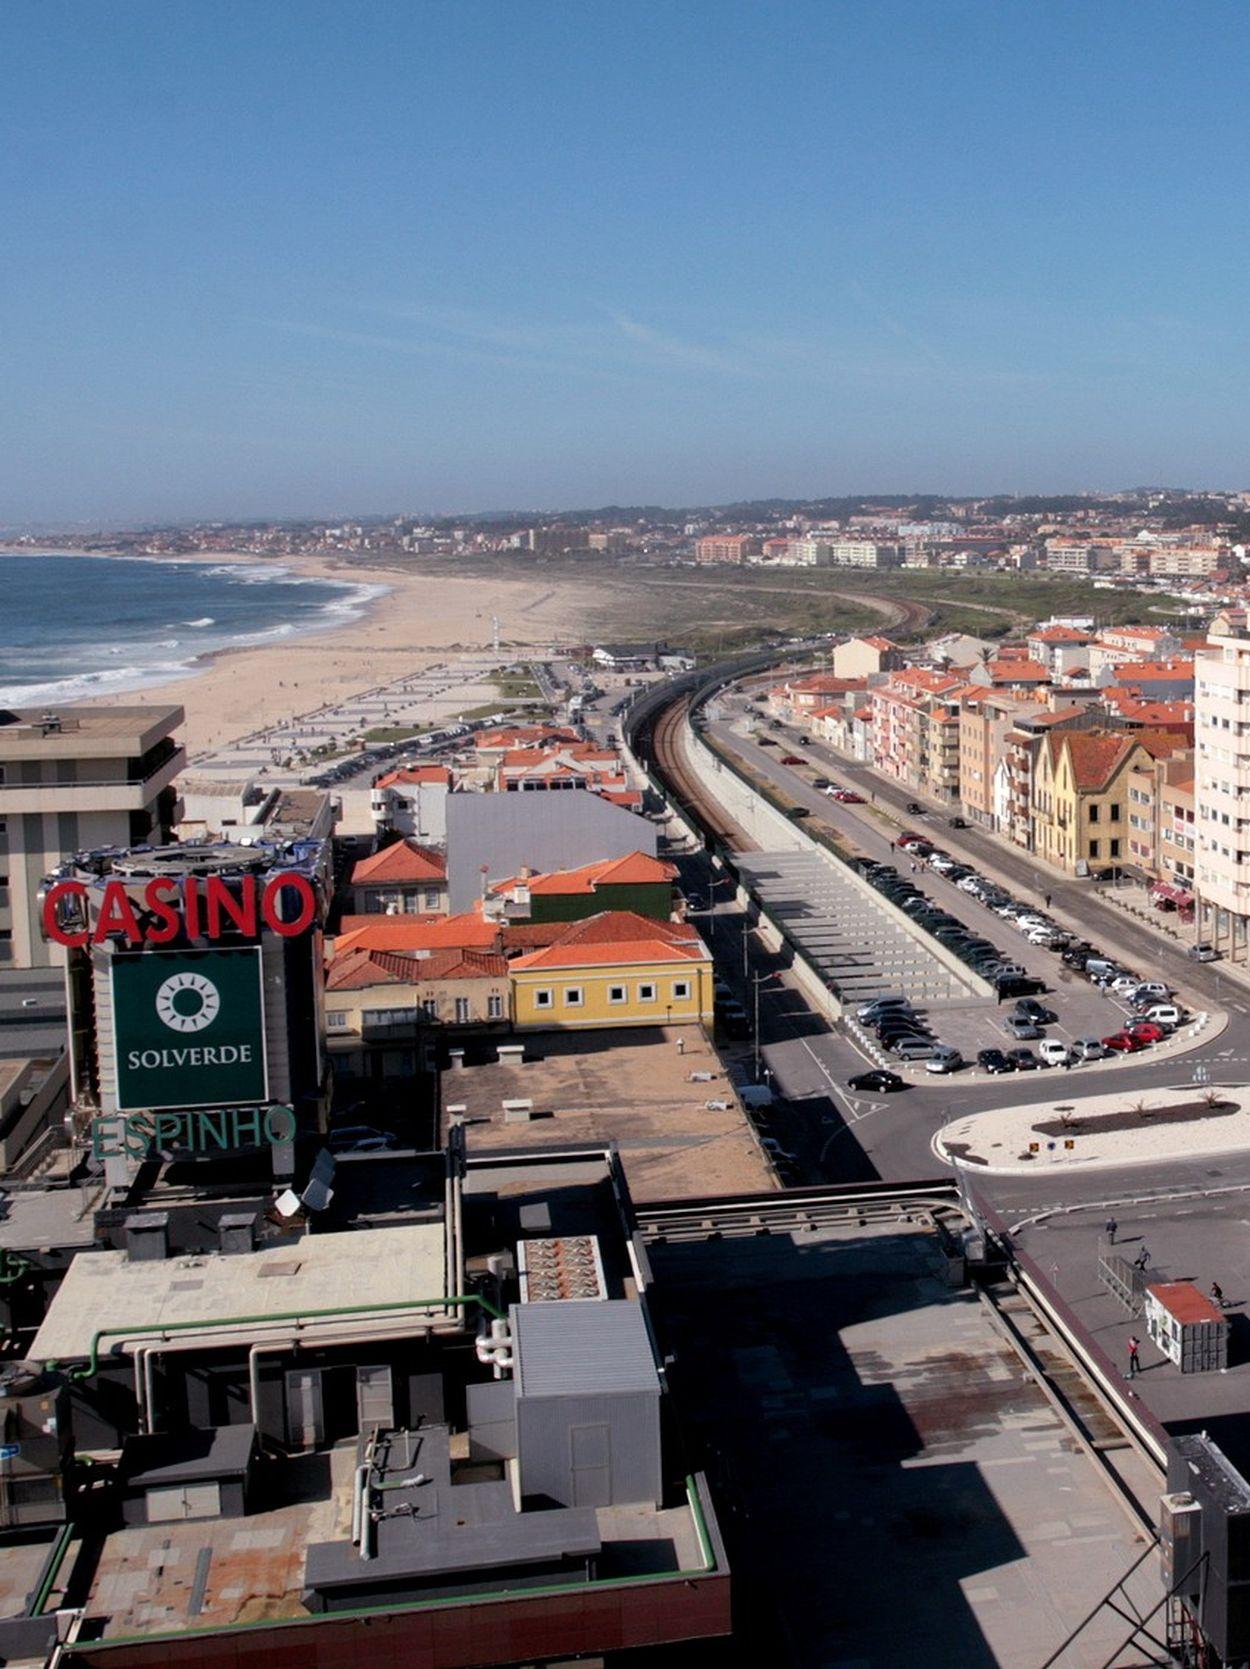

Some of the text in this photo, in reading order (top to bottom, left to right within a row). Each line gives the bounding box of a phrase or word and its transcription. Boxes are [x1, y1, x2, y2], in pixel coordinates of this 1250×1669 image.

[44, 873, 316, 947] CASINO
[128, 1044, 252, 1070] SOLVERDE
[92, 1105, 297, 1159] ESPINHO
